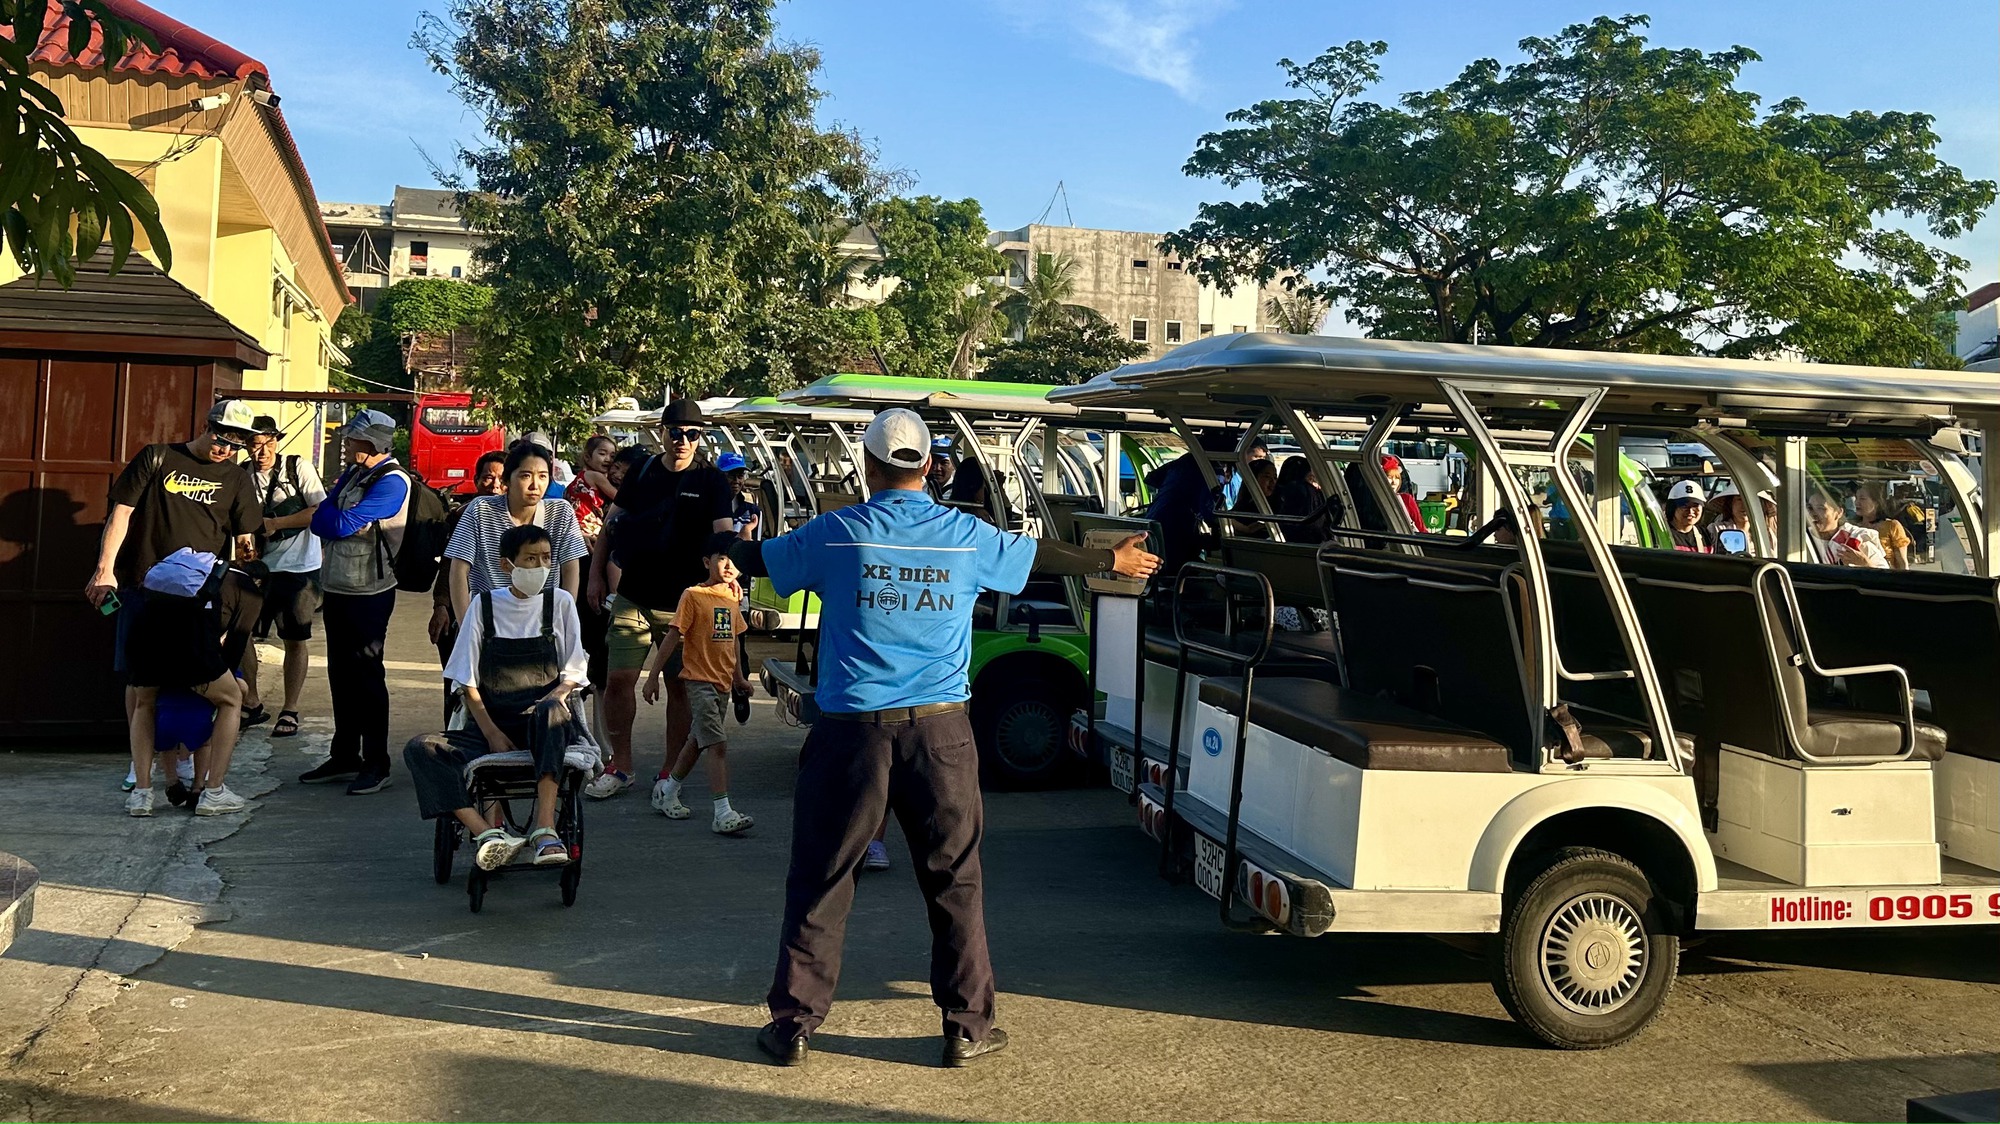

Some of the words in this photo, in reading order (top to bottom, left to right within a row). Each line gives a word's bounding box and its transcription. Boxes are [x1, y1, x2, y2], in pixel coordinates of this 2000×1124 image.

[175, 473, 216, 505] AIR
[862, 564, 892, 581] XE
[914, 588, 954, 612] AN
[1201, 839, 1224, 873] 92HC
[1771, 896, 1852, 922] Hotline:
[1869, 894, 1973, 921] 0905
